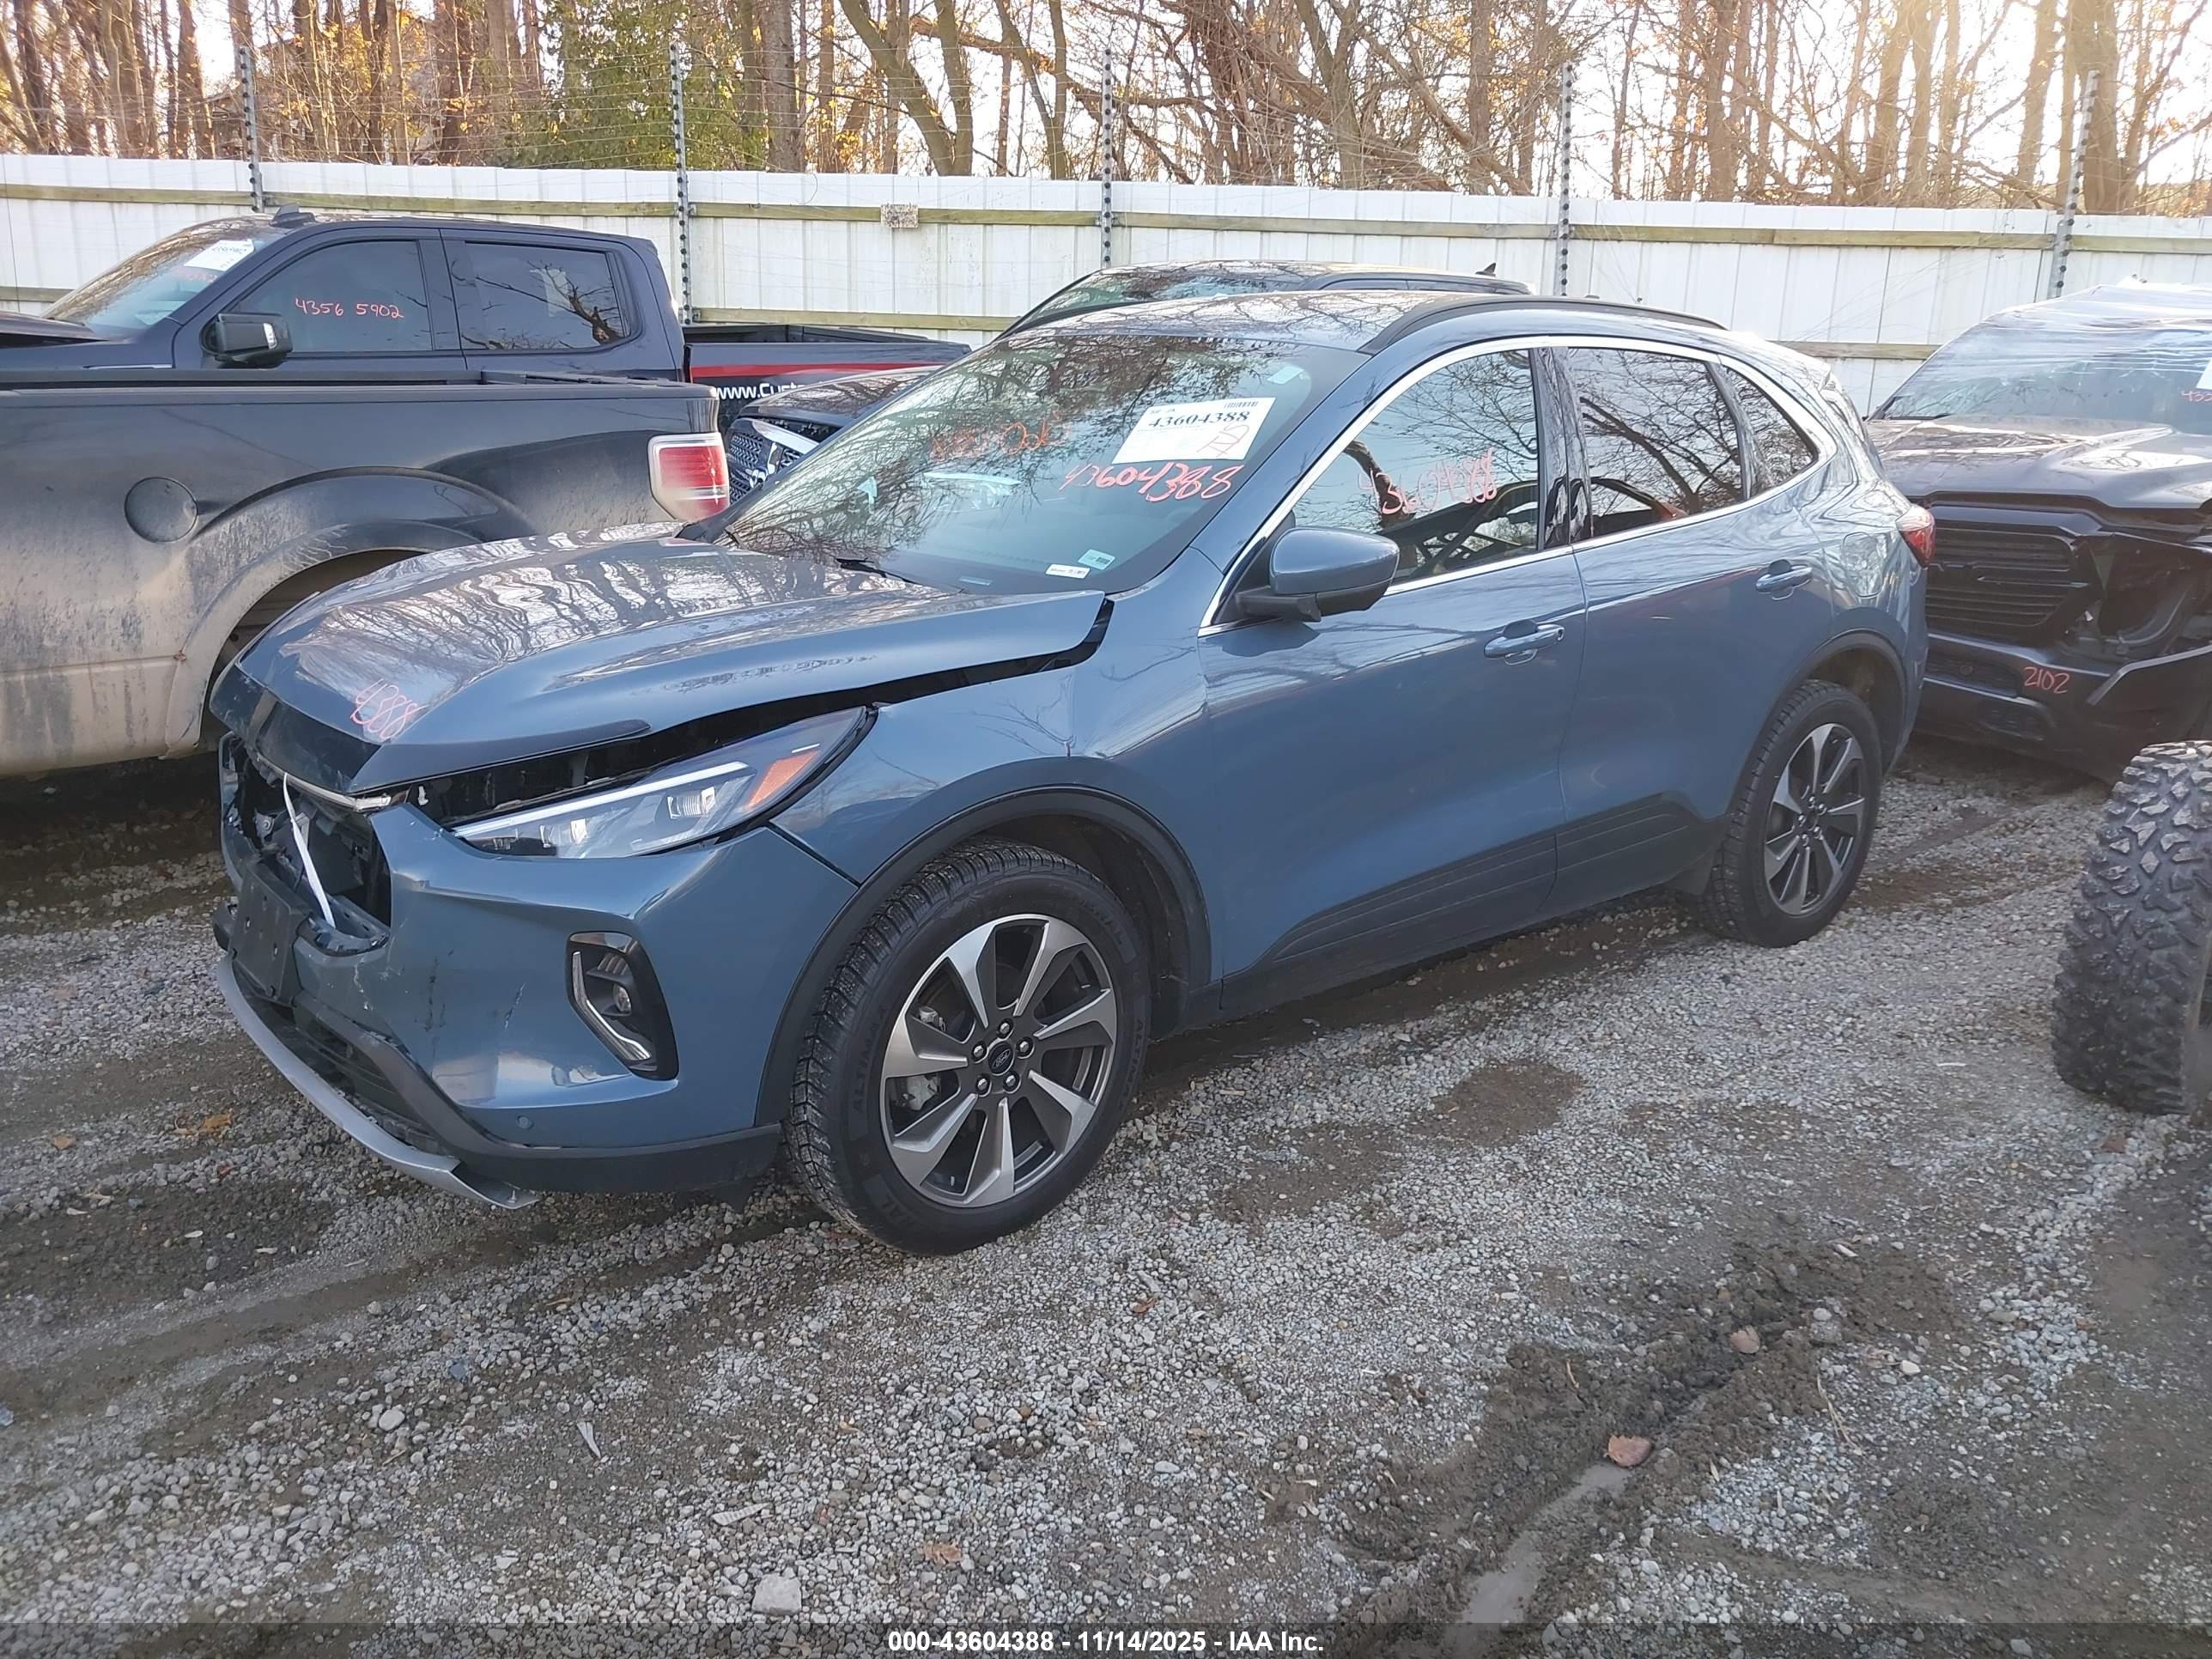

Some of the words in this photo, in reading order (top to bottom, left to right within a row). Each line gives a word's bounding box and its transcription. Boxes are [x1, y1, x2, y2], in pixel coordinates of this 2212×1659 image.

[295, 297, 343, 317] 4356
[356, 303, 404, 319] 5902
[716, 381, 805, 398] www.Cust
[1148, 411, 1250, 428] 43604388
[1058, 461, 1245, 502] 43604388
[2024, 666, 2069, 694] 2102
[349, 678, 428, 740] 4388
